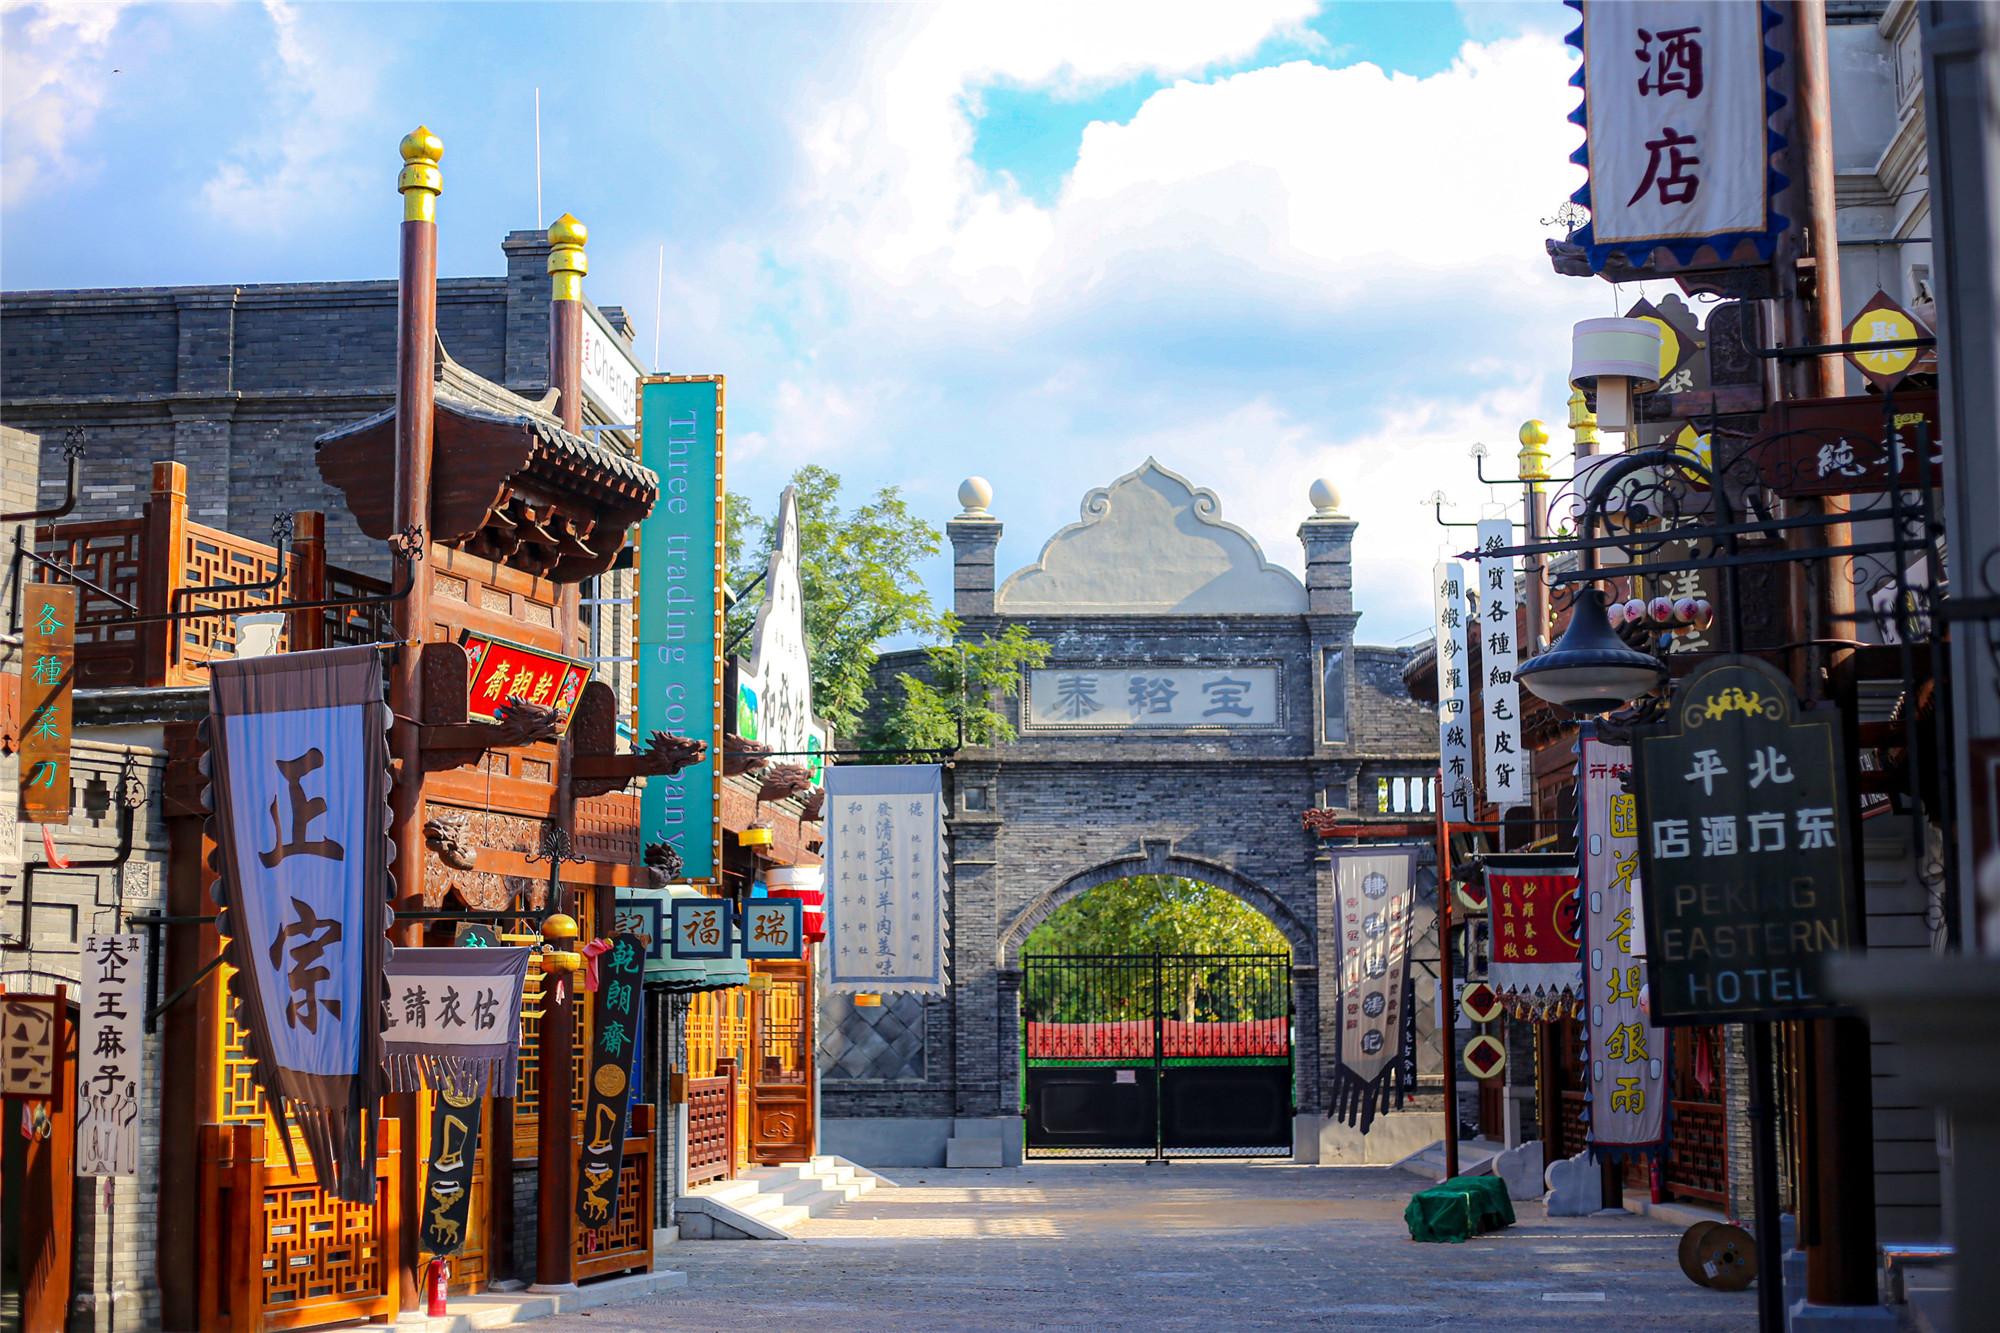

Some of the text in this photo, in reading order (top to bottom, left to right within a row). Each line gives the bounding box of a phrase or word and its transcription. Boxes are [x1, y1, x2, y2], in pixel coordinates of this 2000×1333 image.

[1627, 26, 1704, 208] 酒店
[29, 602, 66, 788] 各種菜刀
[656, 409, 697, 850] Three trading coany
[258, 747, 344, 1035] 正宗
[1663, 918, 1839, 962] EASTERN
[1676, 876, 1816, 917] PEKING
[1688, 967, 1816, 1005] HOTEL
